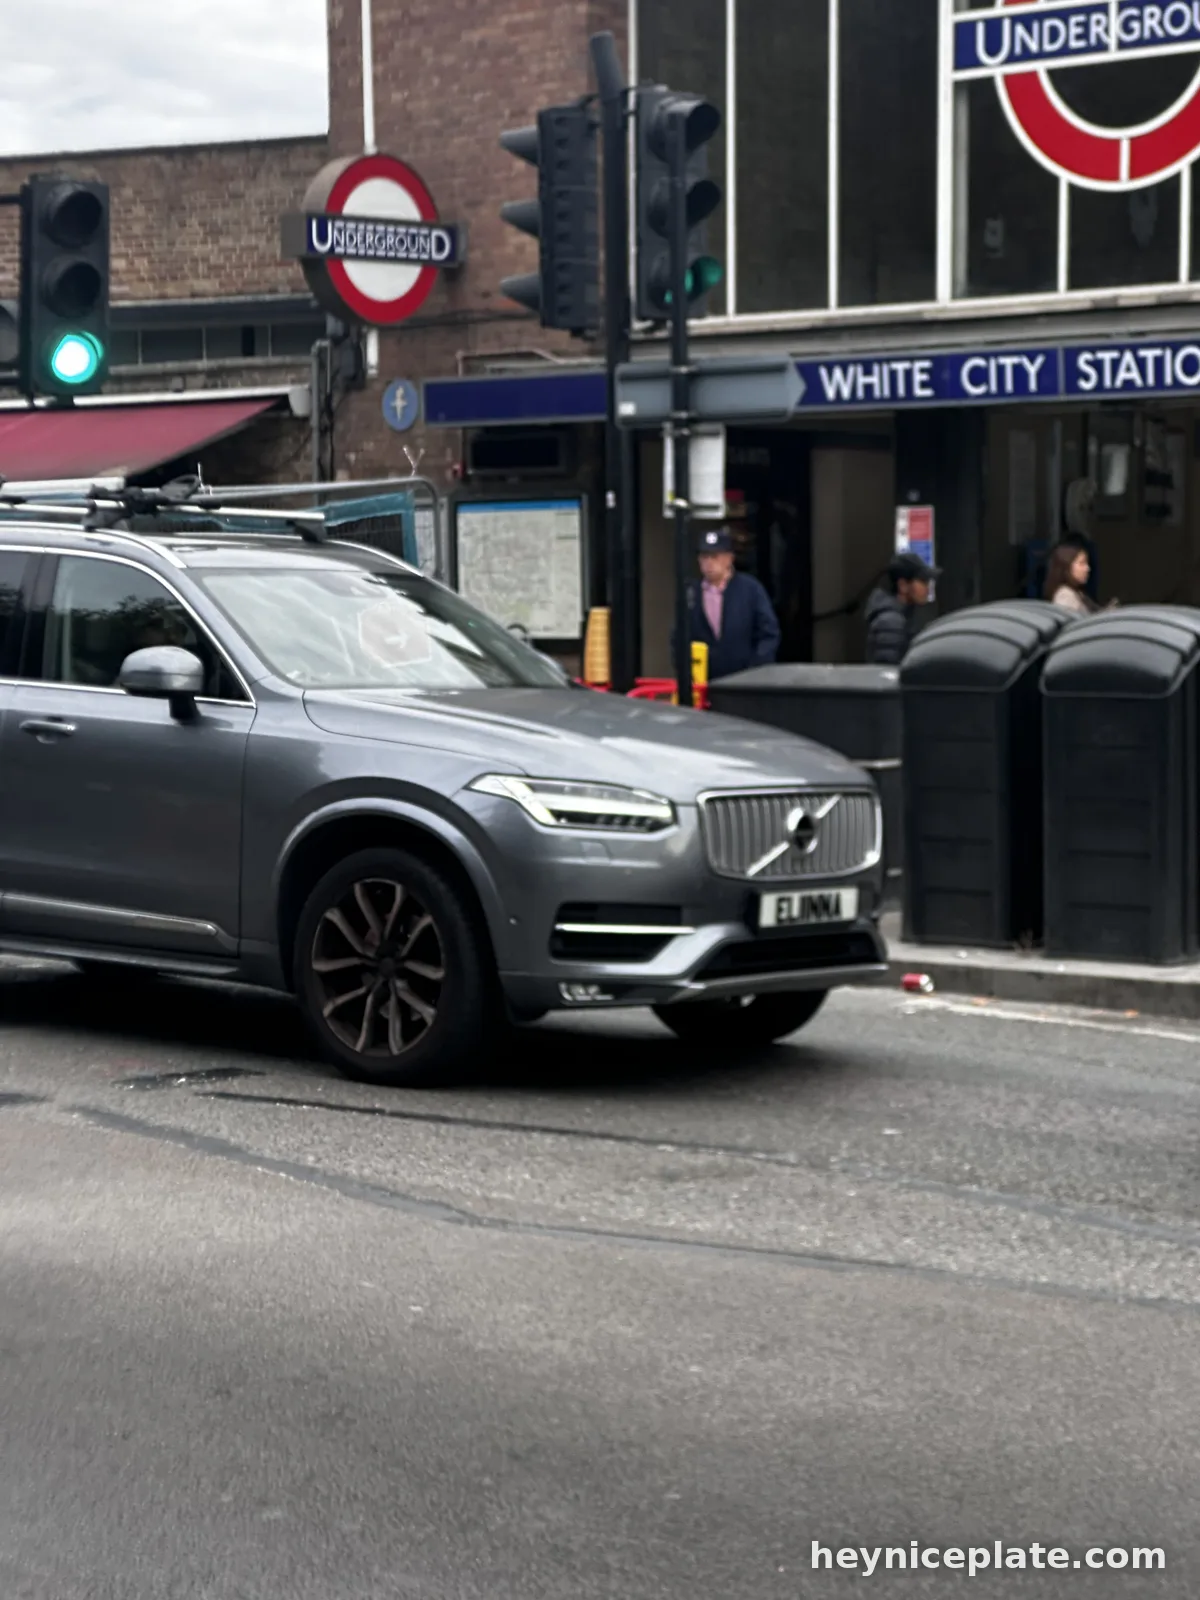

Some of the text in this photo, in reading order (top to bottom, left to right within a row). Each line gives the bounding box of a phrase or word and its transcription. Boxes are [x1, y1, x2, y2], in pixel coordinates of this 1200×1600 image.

[311, 217, 452, 261] UNDERGROUND
[819, 360, 935, 401] WHITE
[960, 354, 1046, 397] CITY
